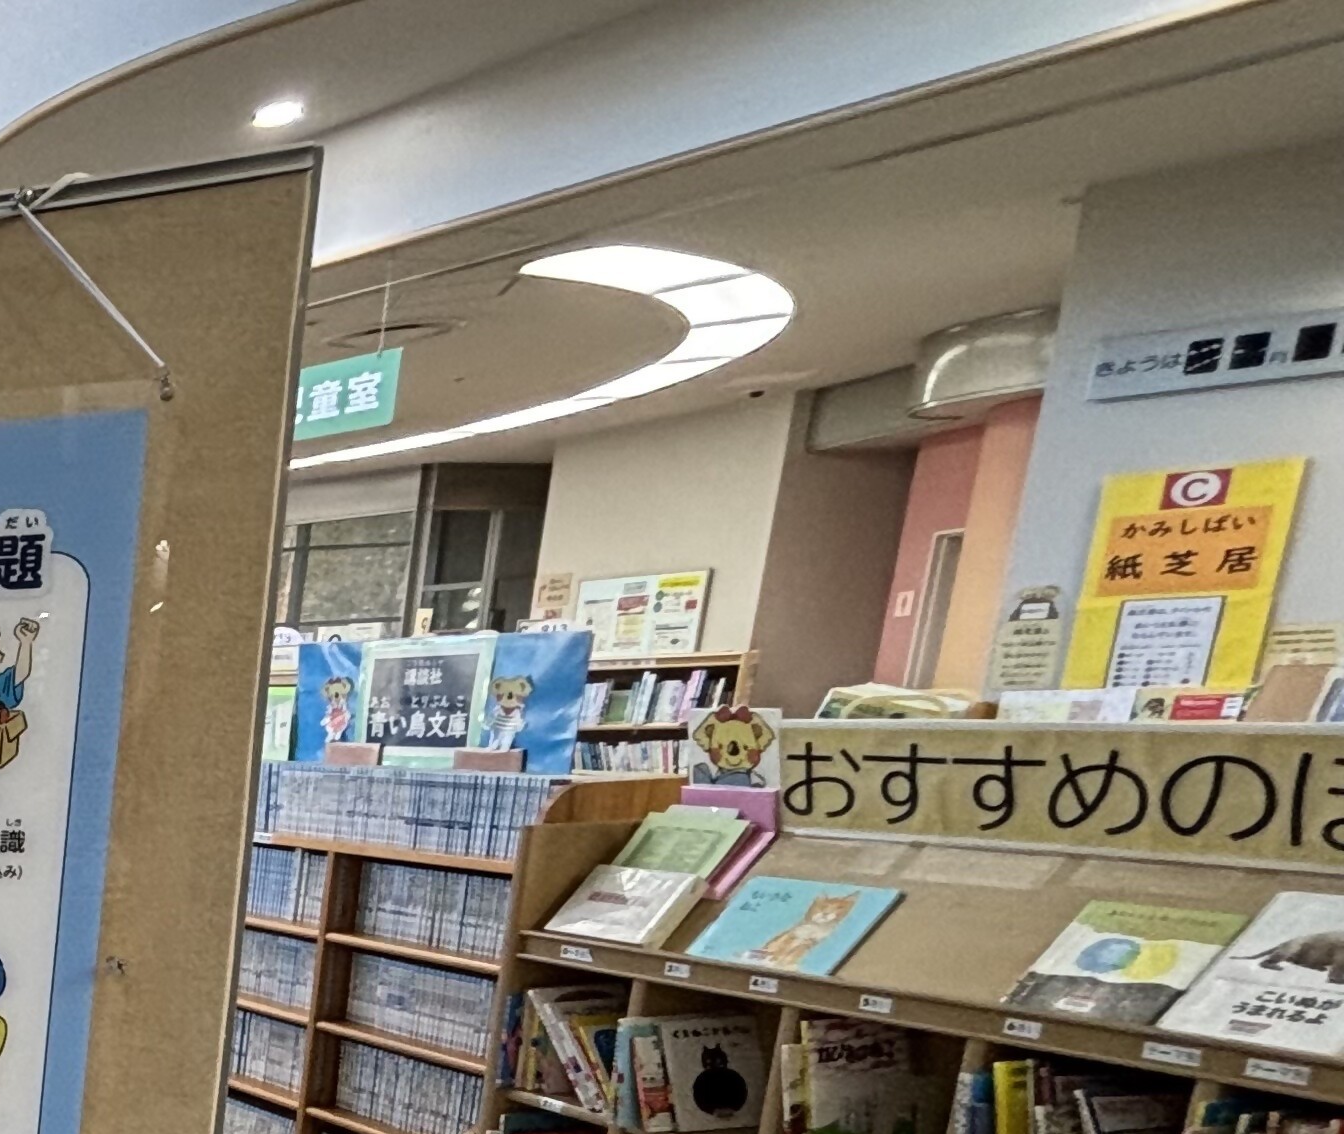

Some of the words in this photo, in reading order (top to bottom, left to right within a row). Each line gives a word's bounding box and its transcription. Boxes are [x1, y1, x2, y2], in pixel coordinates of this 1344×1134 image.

[1095, 355, 1181, 377] きょうは
[294, 371, 382, 425] 童室
[1183, 478, 1209, 502] C
[1120, 516, 1256, 538] かみしばい
[1105, 547, 1258, 580] 紙芝居
[368, 712, 467, 740] 青い鳥文庫
